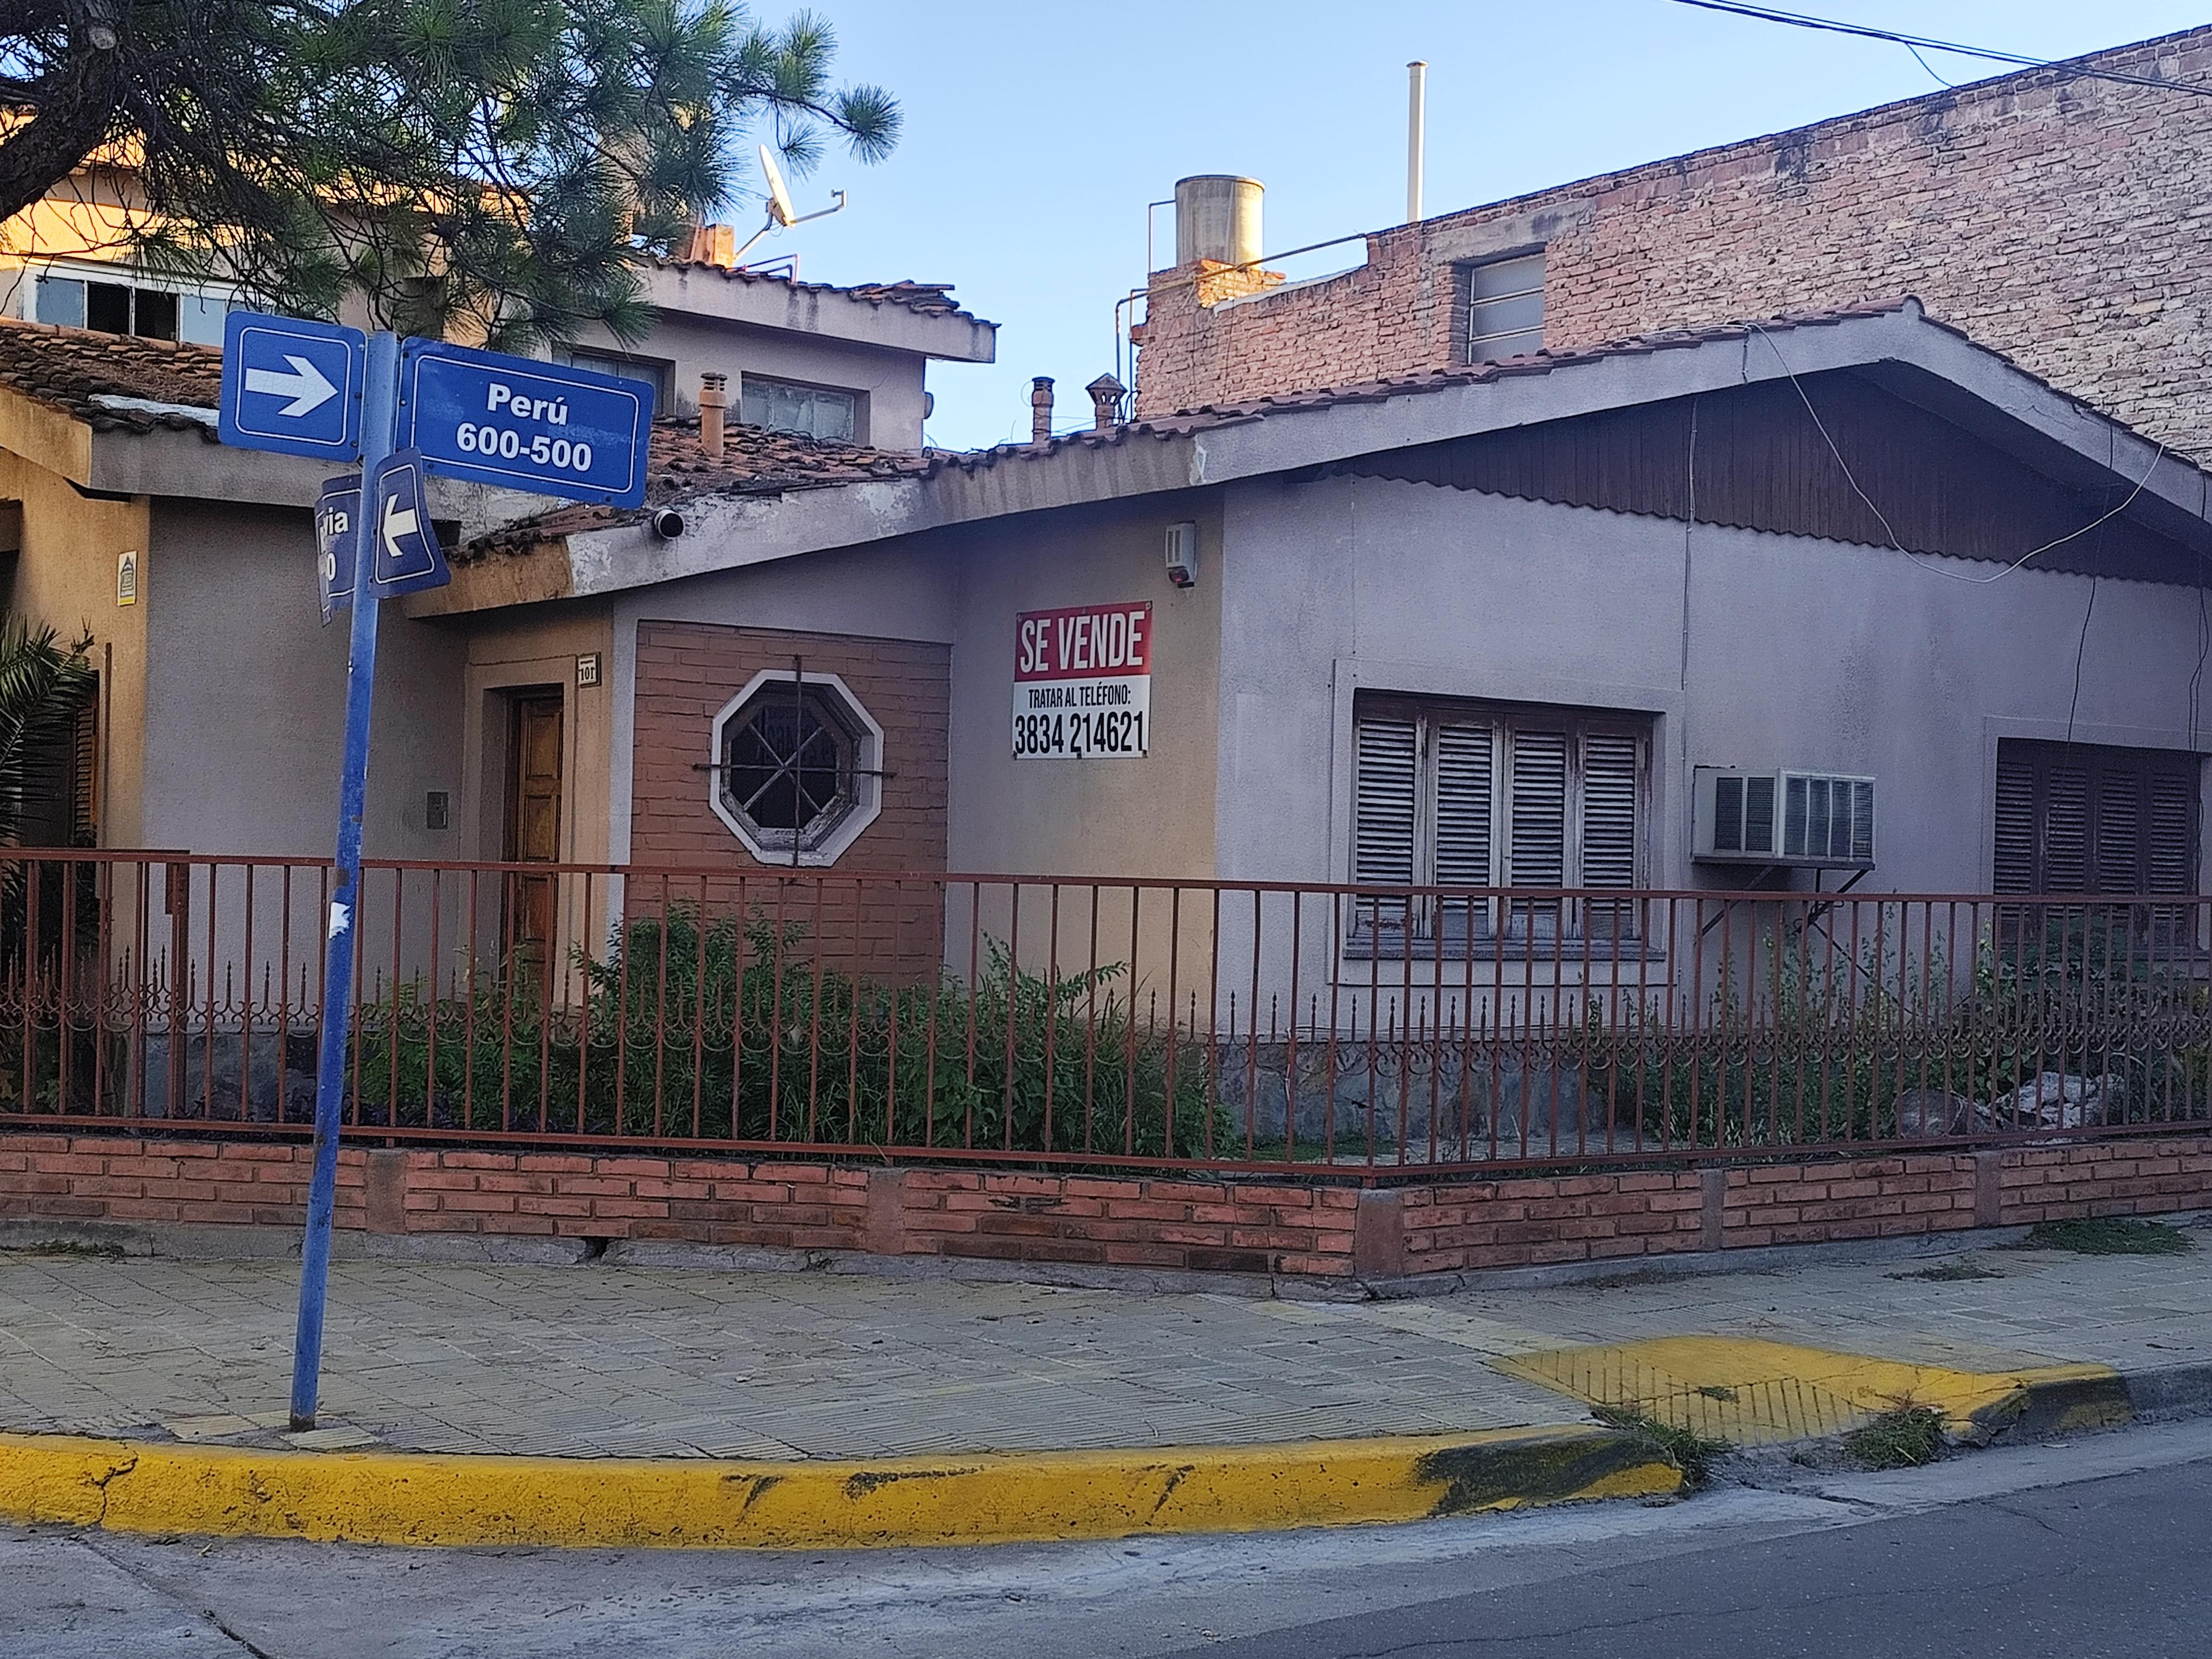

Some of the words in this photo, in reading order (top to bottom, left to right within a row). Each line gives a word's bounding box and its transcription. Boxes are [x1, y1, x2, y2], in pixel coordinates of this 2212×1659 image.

[487, 382, 568, 426] Perú
[456, 422, 592, 472] 600-500
[1020, 619, 1051, 673] SE
[1058, 610, 1145, 670] VENDE
[1028, 687, 1063, 709] TRATAR
[1065, 687, 1077, 708] AL
[1079, 681, 1131, 707] TELÉFONO:
[1015, 714, 1064, 754] 3834
[1070, 711, 1143, 753] 214621
